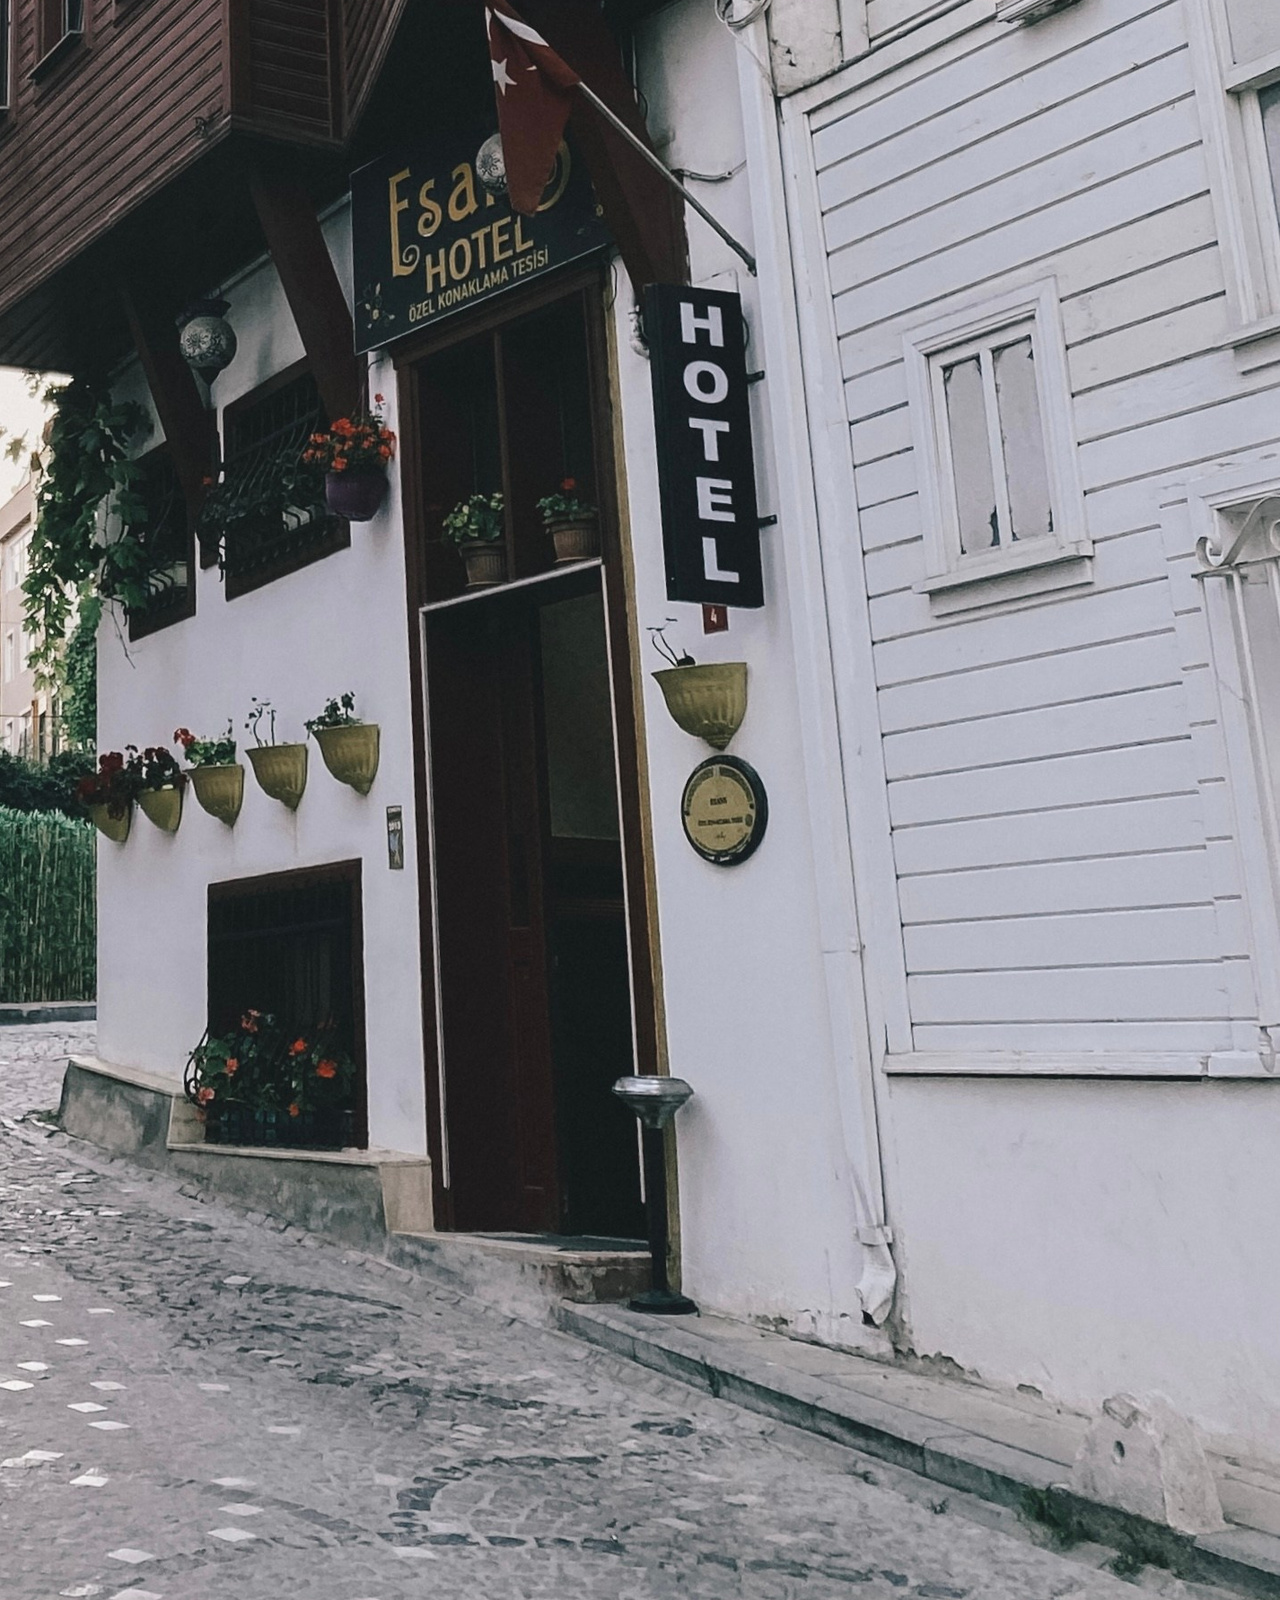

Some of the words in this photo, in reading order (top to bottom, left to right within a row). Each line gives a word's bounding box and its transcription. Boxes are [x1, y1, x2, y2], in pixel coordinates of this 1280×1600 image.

[388, 138, 571, 277] Esa
[408, 298, 435, 323] ÖZEL
[437, 266, 509, 311] KONAKLAMA
[510, 244, 549, 278] TESİSİ
[425, 215, 534, 294] HOTEL
[679, 301, 740, 584] HOTEL
[710, 607, 718, 625] 4
